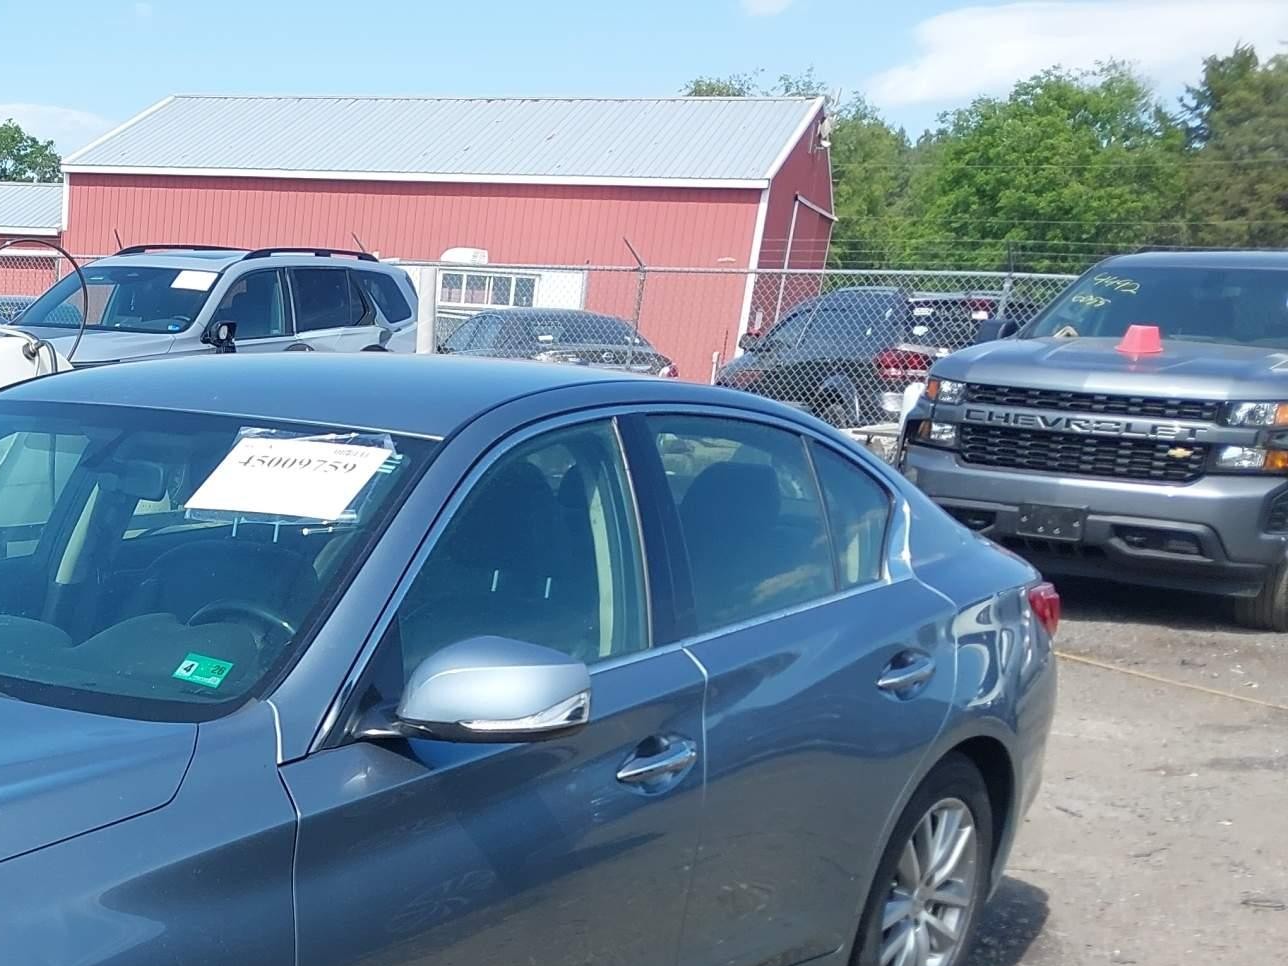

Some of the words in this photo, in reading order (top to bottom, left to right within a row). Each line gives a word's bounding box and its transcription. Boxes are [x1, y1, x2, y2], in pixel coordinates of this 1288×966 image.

[964, 408, 1208, 440] CHEVROLET
[238, 455, 357, 473] 45009759
[183, 663, 195, 673] 4
